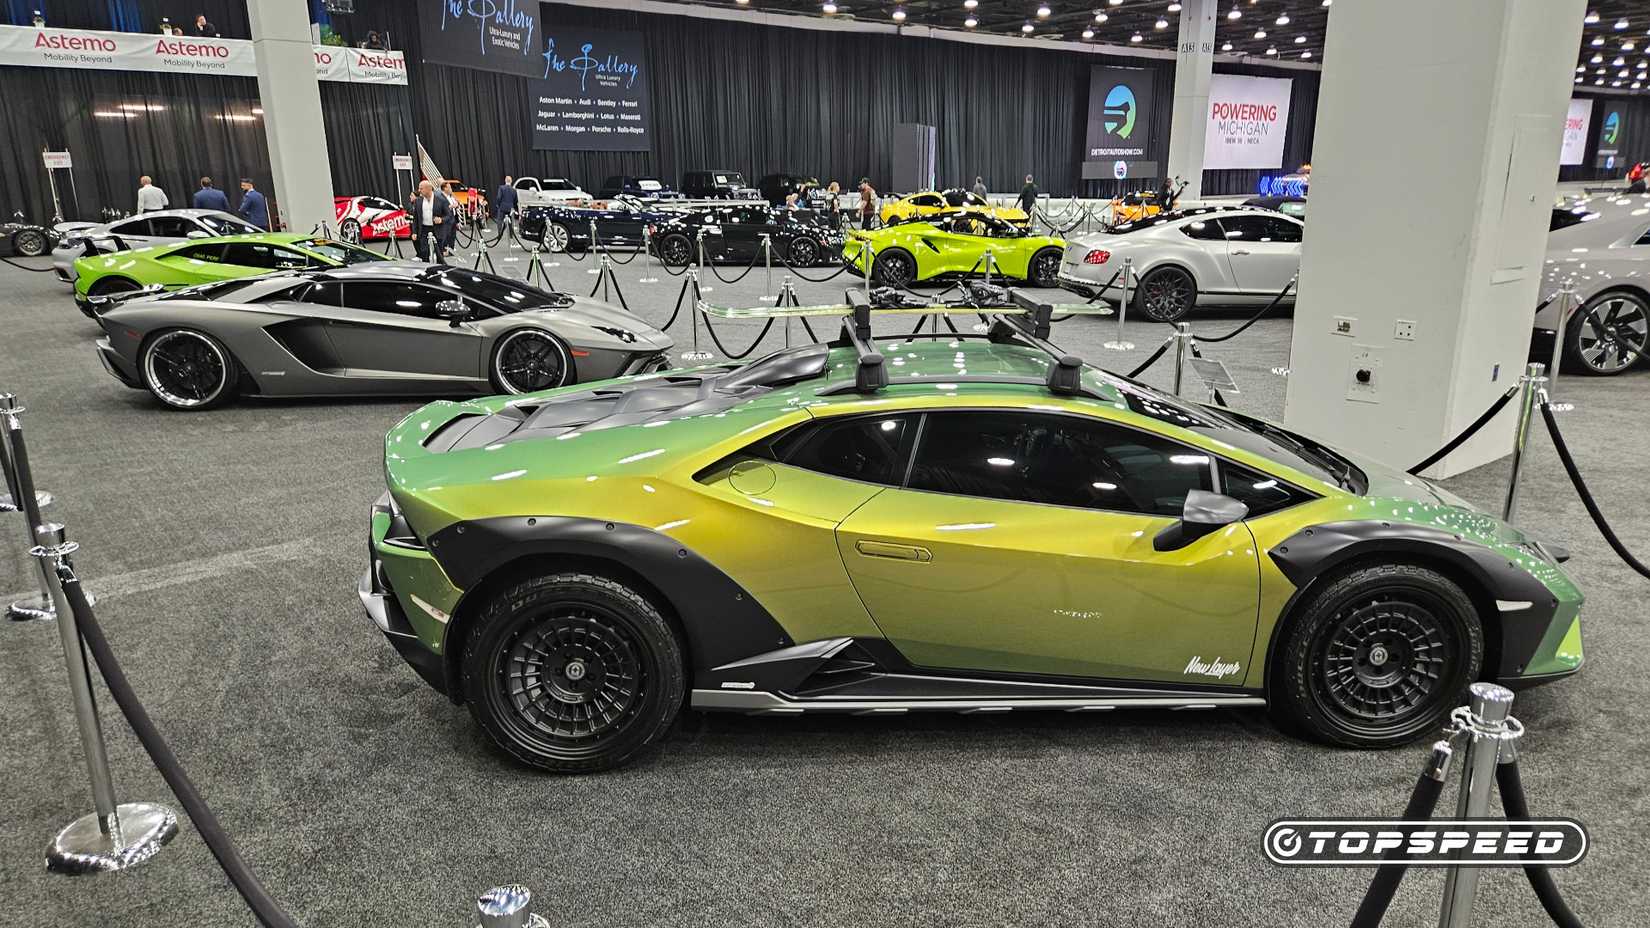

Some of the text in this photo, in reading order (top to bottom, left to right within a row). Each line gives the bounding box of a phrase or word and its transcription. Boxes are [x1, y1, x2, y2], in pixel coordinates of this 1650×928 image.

[35, 32, 116, 52] Astemo
[156, 39, 229, 58] Astemo
[44, 53, 112, 64] Mobility Beyond
[164, 58, 225, 69] Mobility Beyond
[541, 38, 639, 92] The Gallery
[539, 96, 638, 108] Aston Martin Audi Bentley Ferrari
[538, 110, 641, 121] Jaguar Lamborghini Lotus Maserati
[1212, 103, 1277, 122] POWERING
[536, 123, 645, 135] McLaren Morgan Porsche Rolls-Royce
[1218, 121, 1269, 136] MICHIGAN
[1184, 656, 1240, 680] New Layer
